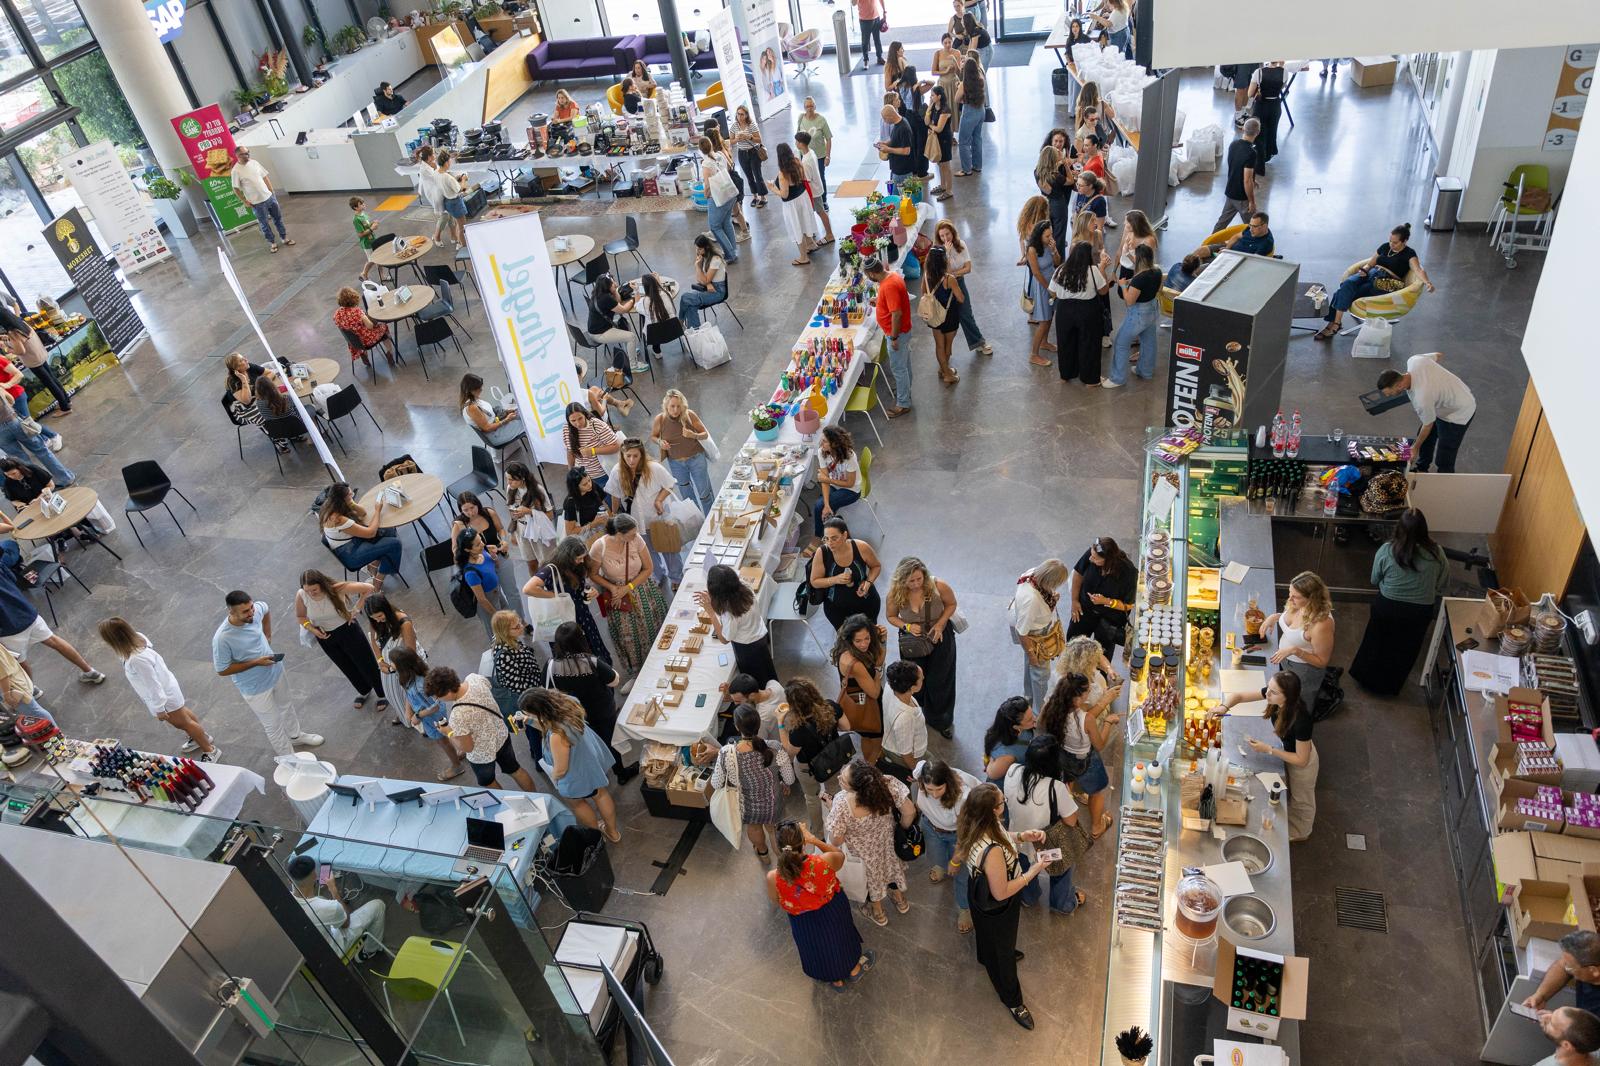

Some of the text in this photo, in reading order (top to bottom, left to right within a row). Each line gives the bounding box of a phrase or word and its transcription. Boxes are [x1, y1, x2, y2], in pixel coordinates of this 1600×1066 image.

[147, 0, 185, 37] SAP
[1570, 50, 1582, 61] G
[67, 245, 94, 270] MORESHET
[1172, 361, 1199, 428] OTEIN
